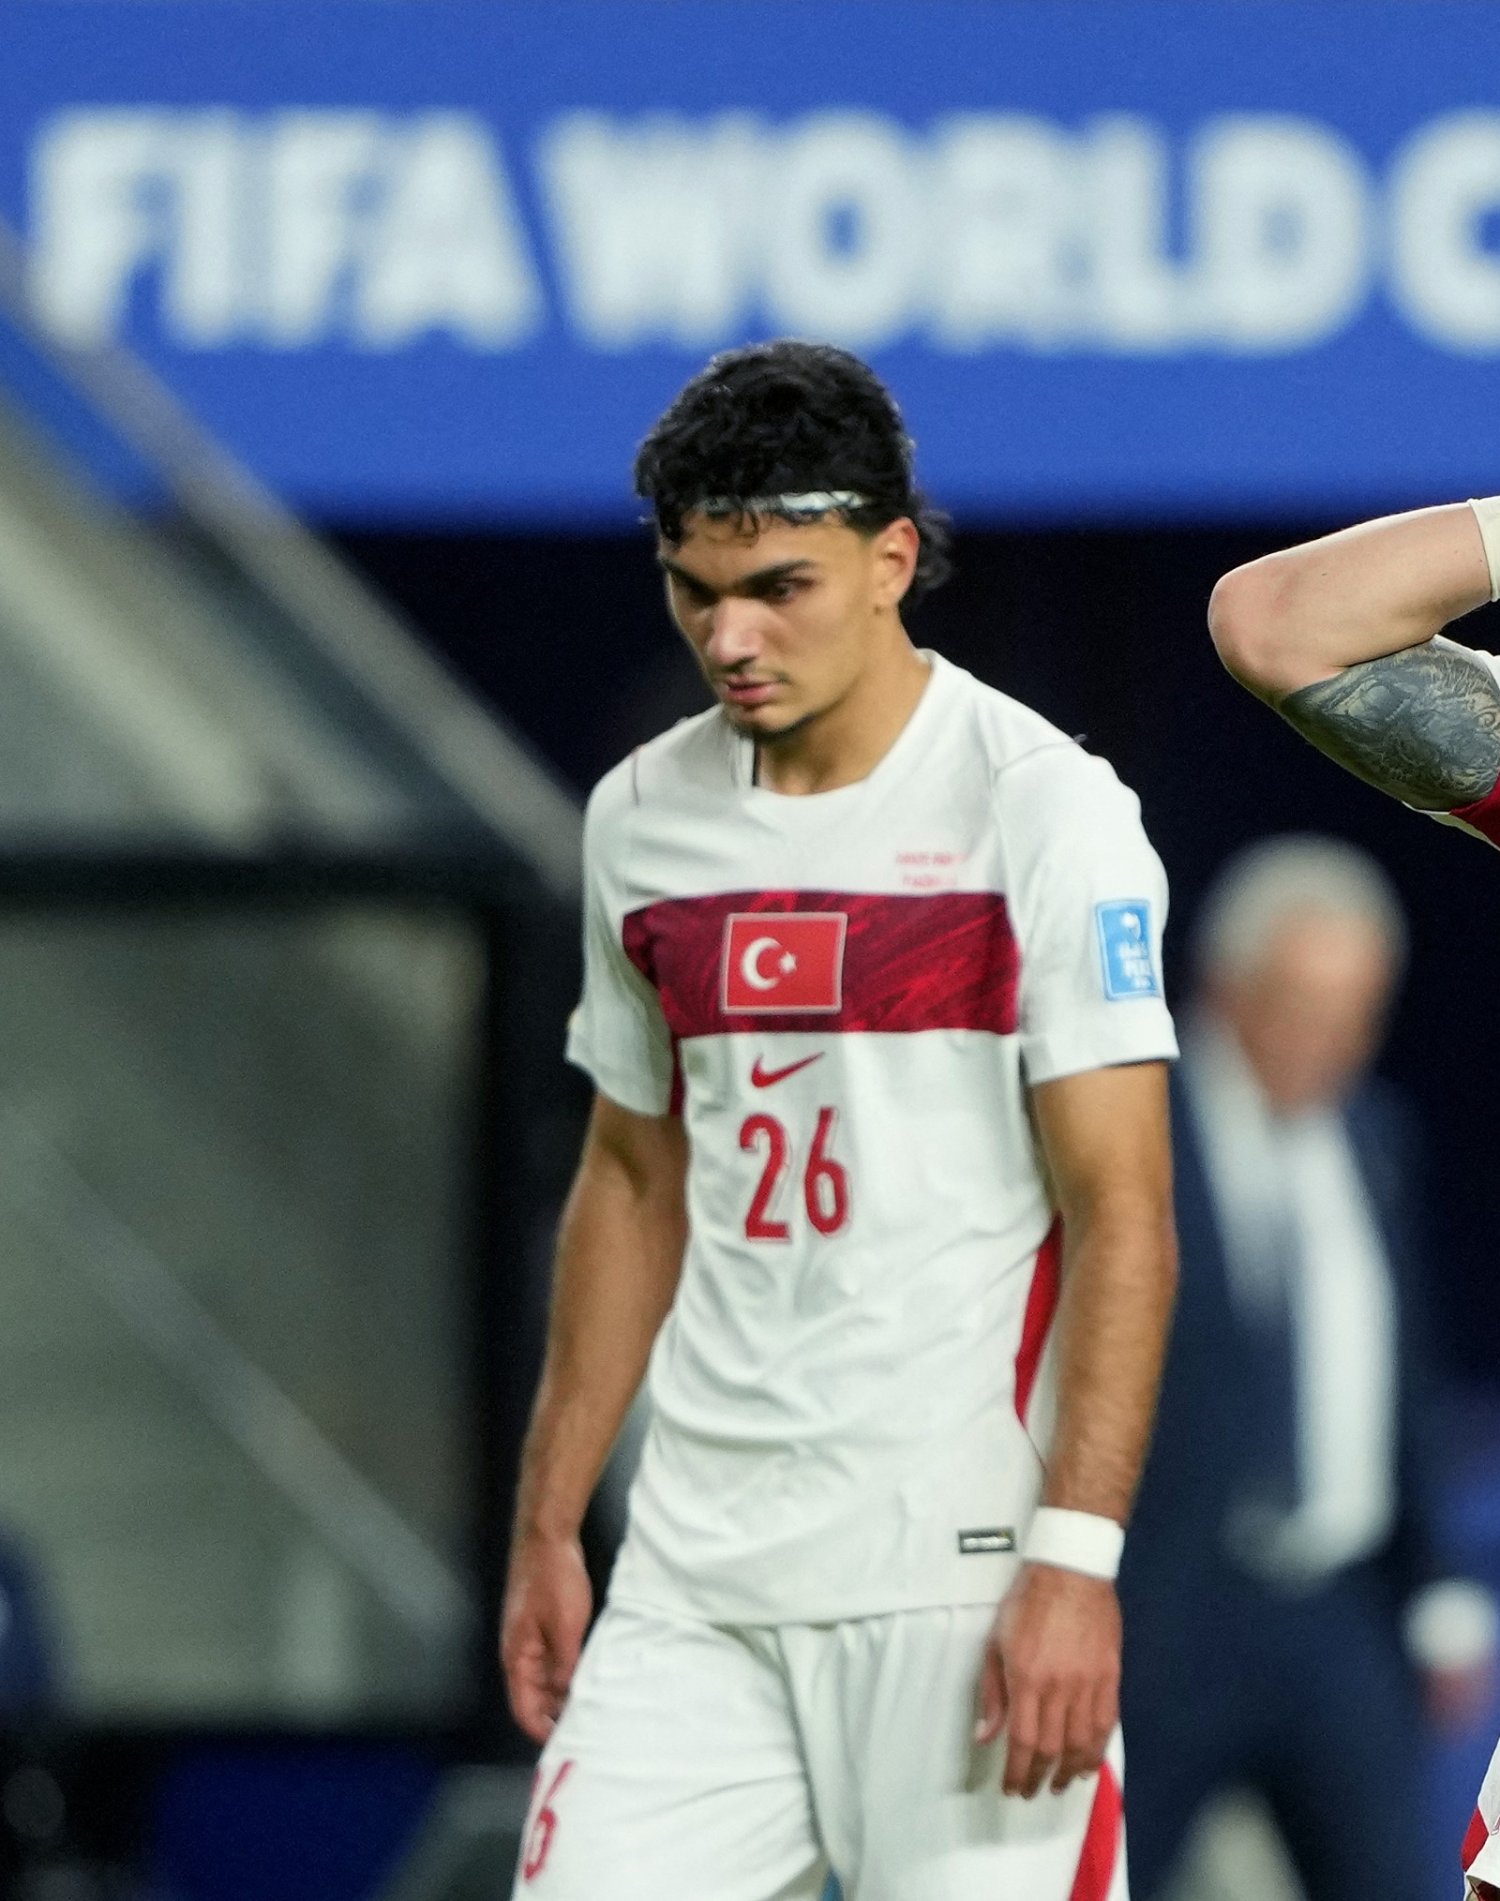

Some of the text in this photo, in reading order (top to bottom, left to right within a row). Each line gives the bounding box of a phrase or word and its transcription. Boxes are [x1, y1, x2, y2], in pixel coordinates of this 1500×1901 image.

[33, 108, 546, 350] FIFA
[533, 110, 1370, 355] WORLD
[739, 1106, 853, 1244] 26
[523, 1758, 577, 1884] 6
